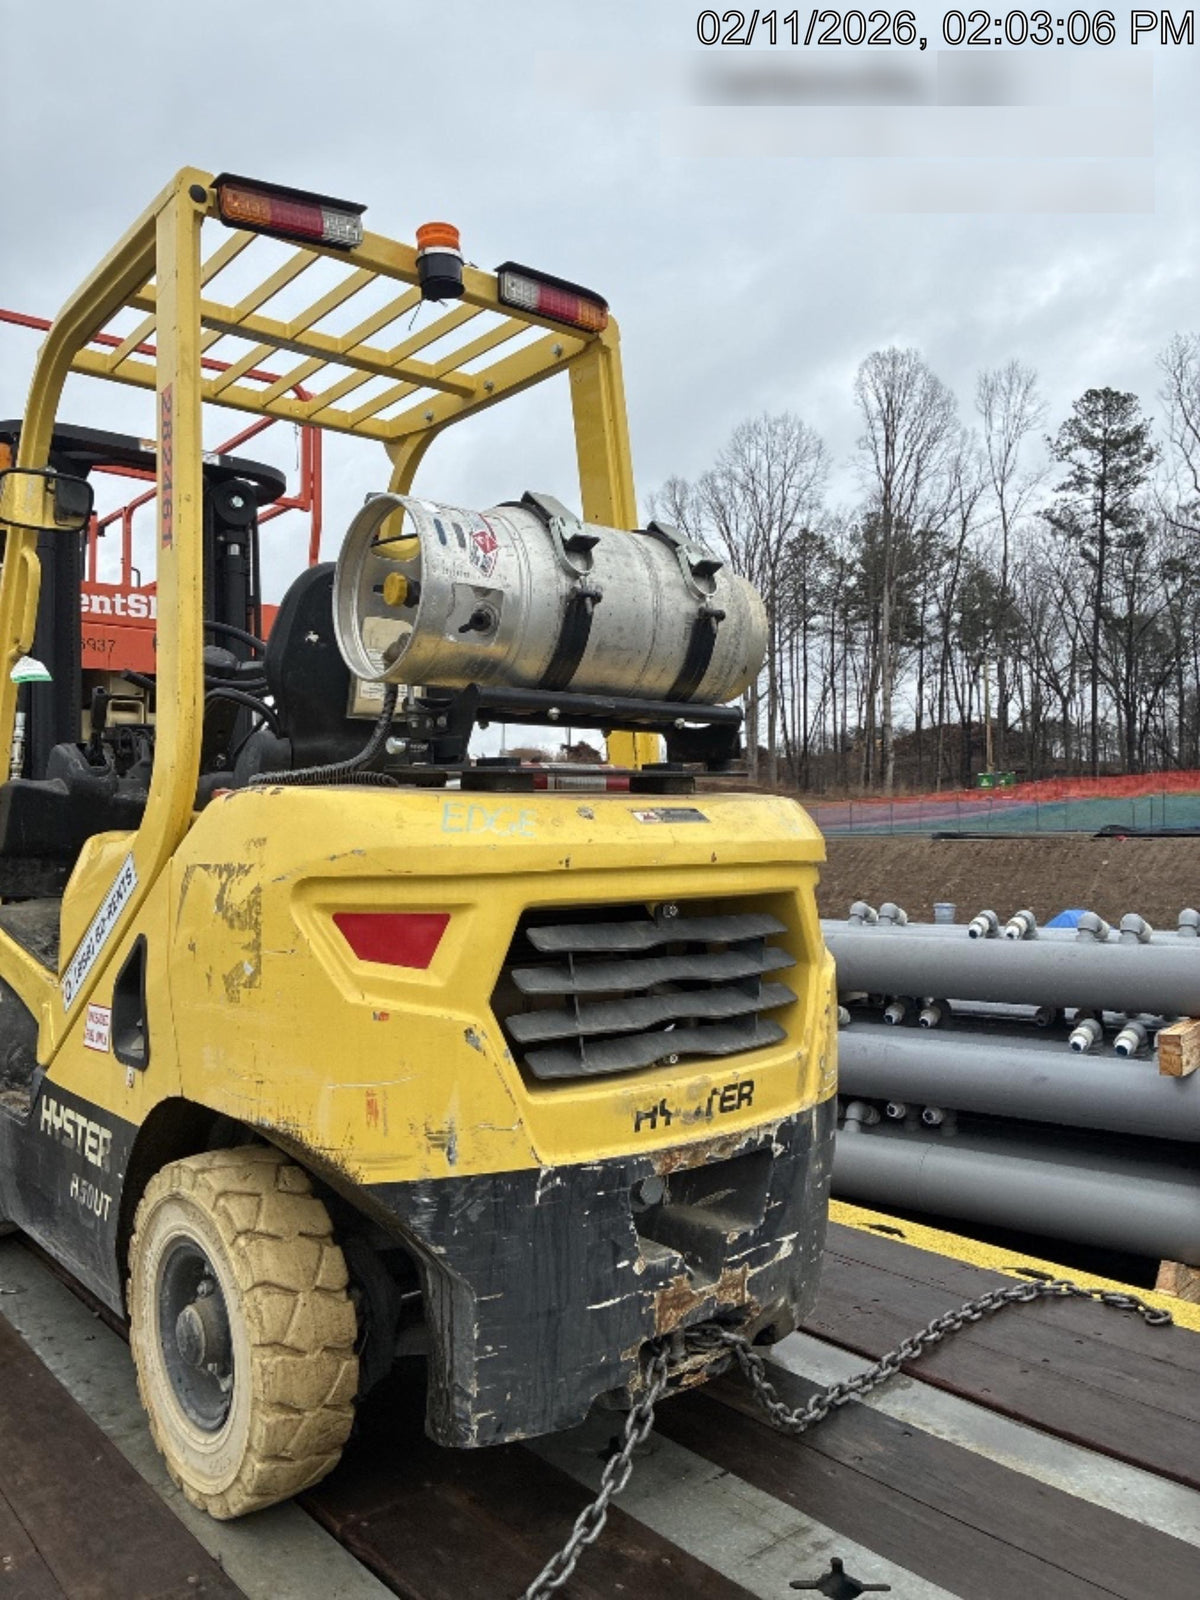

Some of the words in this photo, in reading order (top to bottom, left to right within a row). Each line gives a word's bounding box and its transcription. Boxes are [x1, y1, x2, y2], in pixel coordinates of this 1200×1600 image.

[441, 801, 537, 837] EDGE
[40, 1094, 113, 1167] HYSTER
[634, 1079, 755, 1132] HYTER
